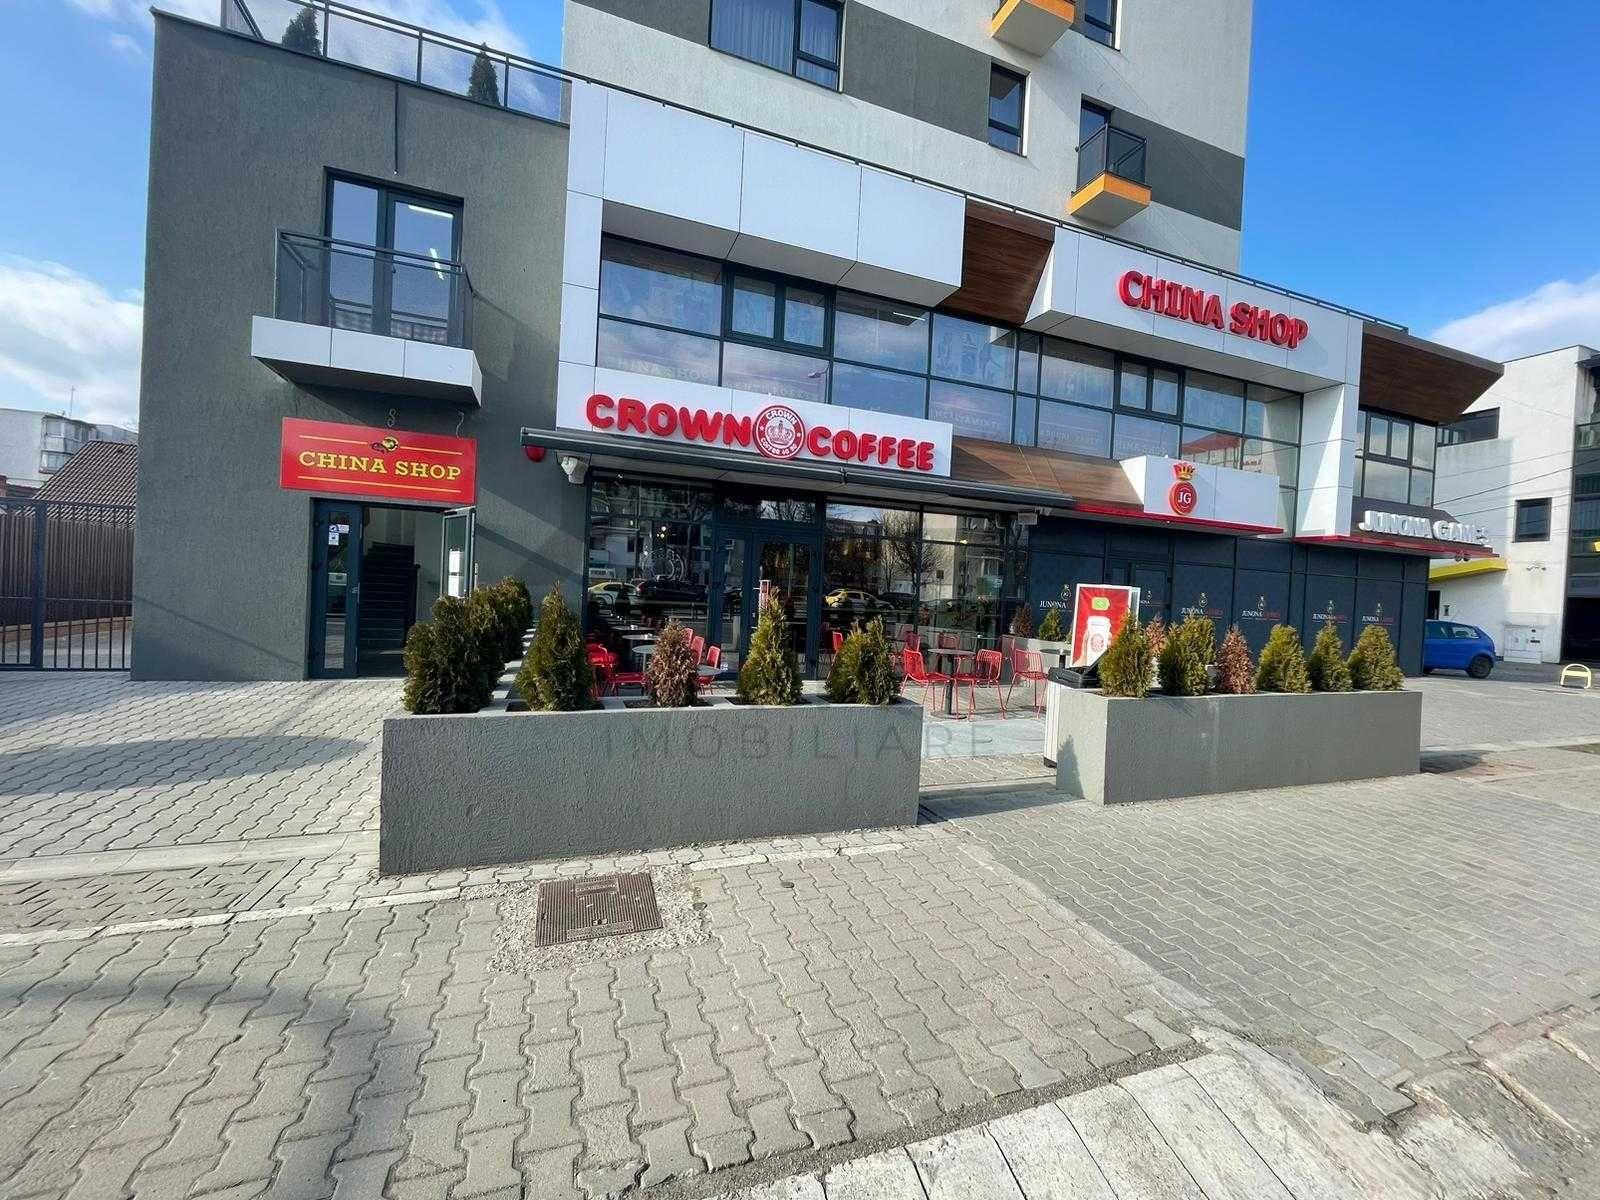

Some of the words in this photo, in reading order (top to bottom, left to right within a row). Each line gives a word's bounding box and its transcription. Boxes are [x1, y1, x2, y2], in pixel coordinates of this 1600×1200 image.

[1119, 270, 1225, 330] CHINA
[1229, 301, 1309, 350] SHOP
[765, 410, 798, 425] CROWN
[586, 394, 752, 447] CROWN
[806, 426, 936, 471] COFFEE
[299, 451, 388, 474] CHINA
[394, 461, 461, 481] SHOP
[1177, 491, 1192, 505] JG
[1358, 510, 1434, 539] JUNONA
